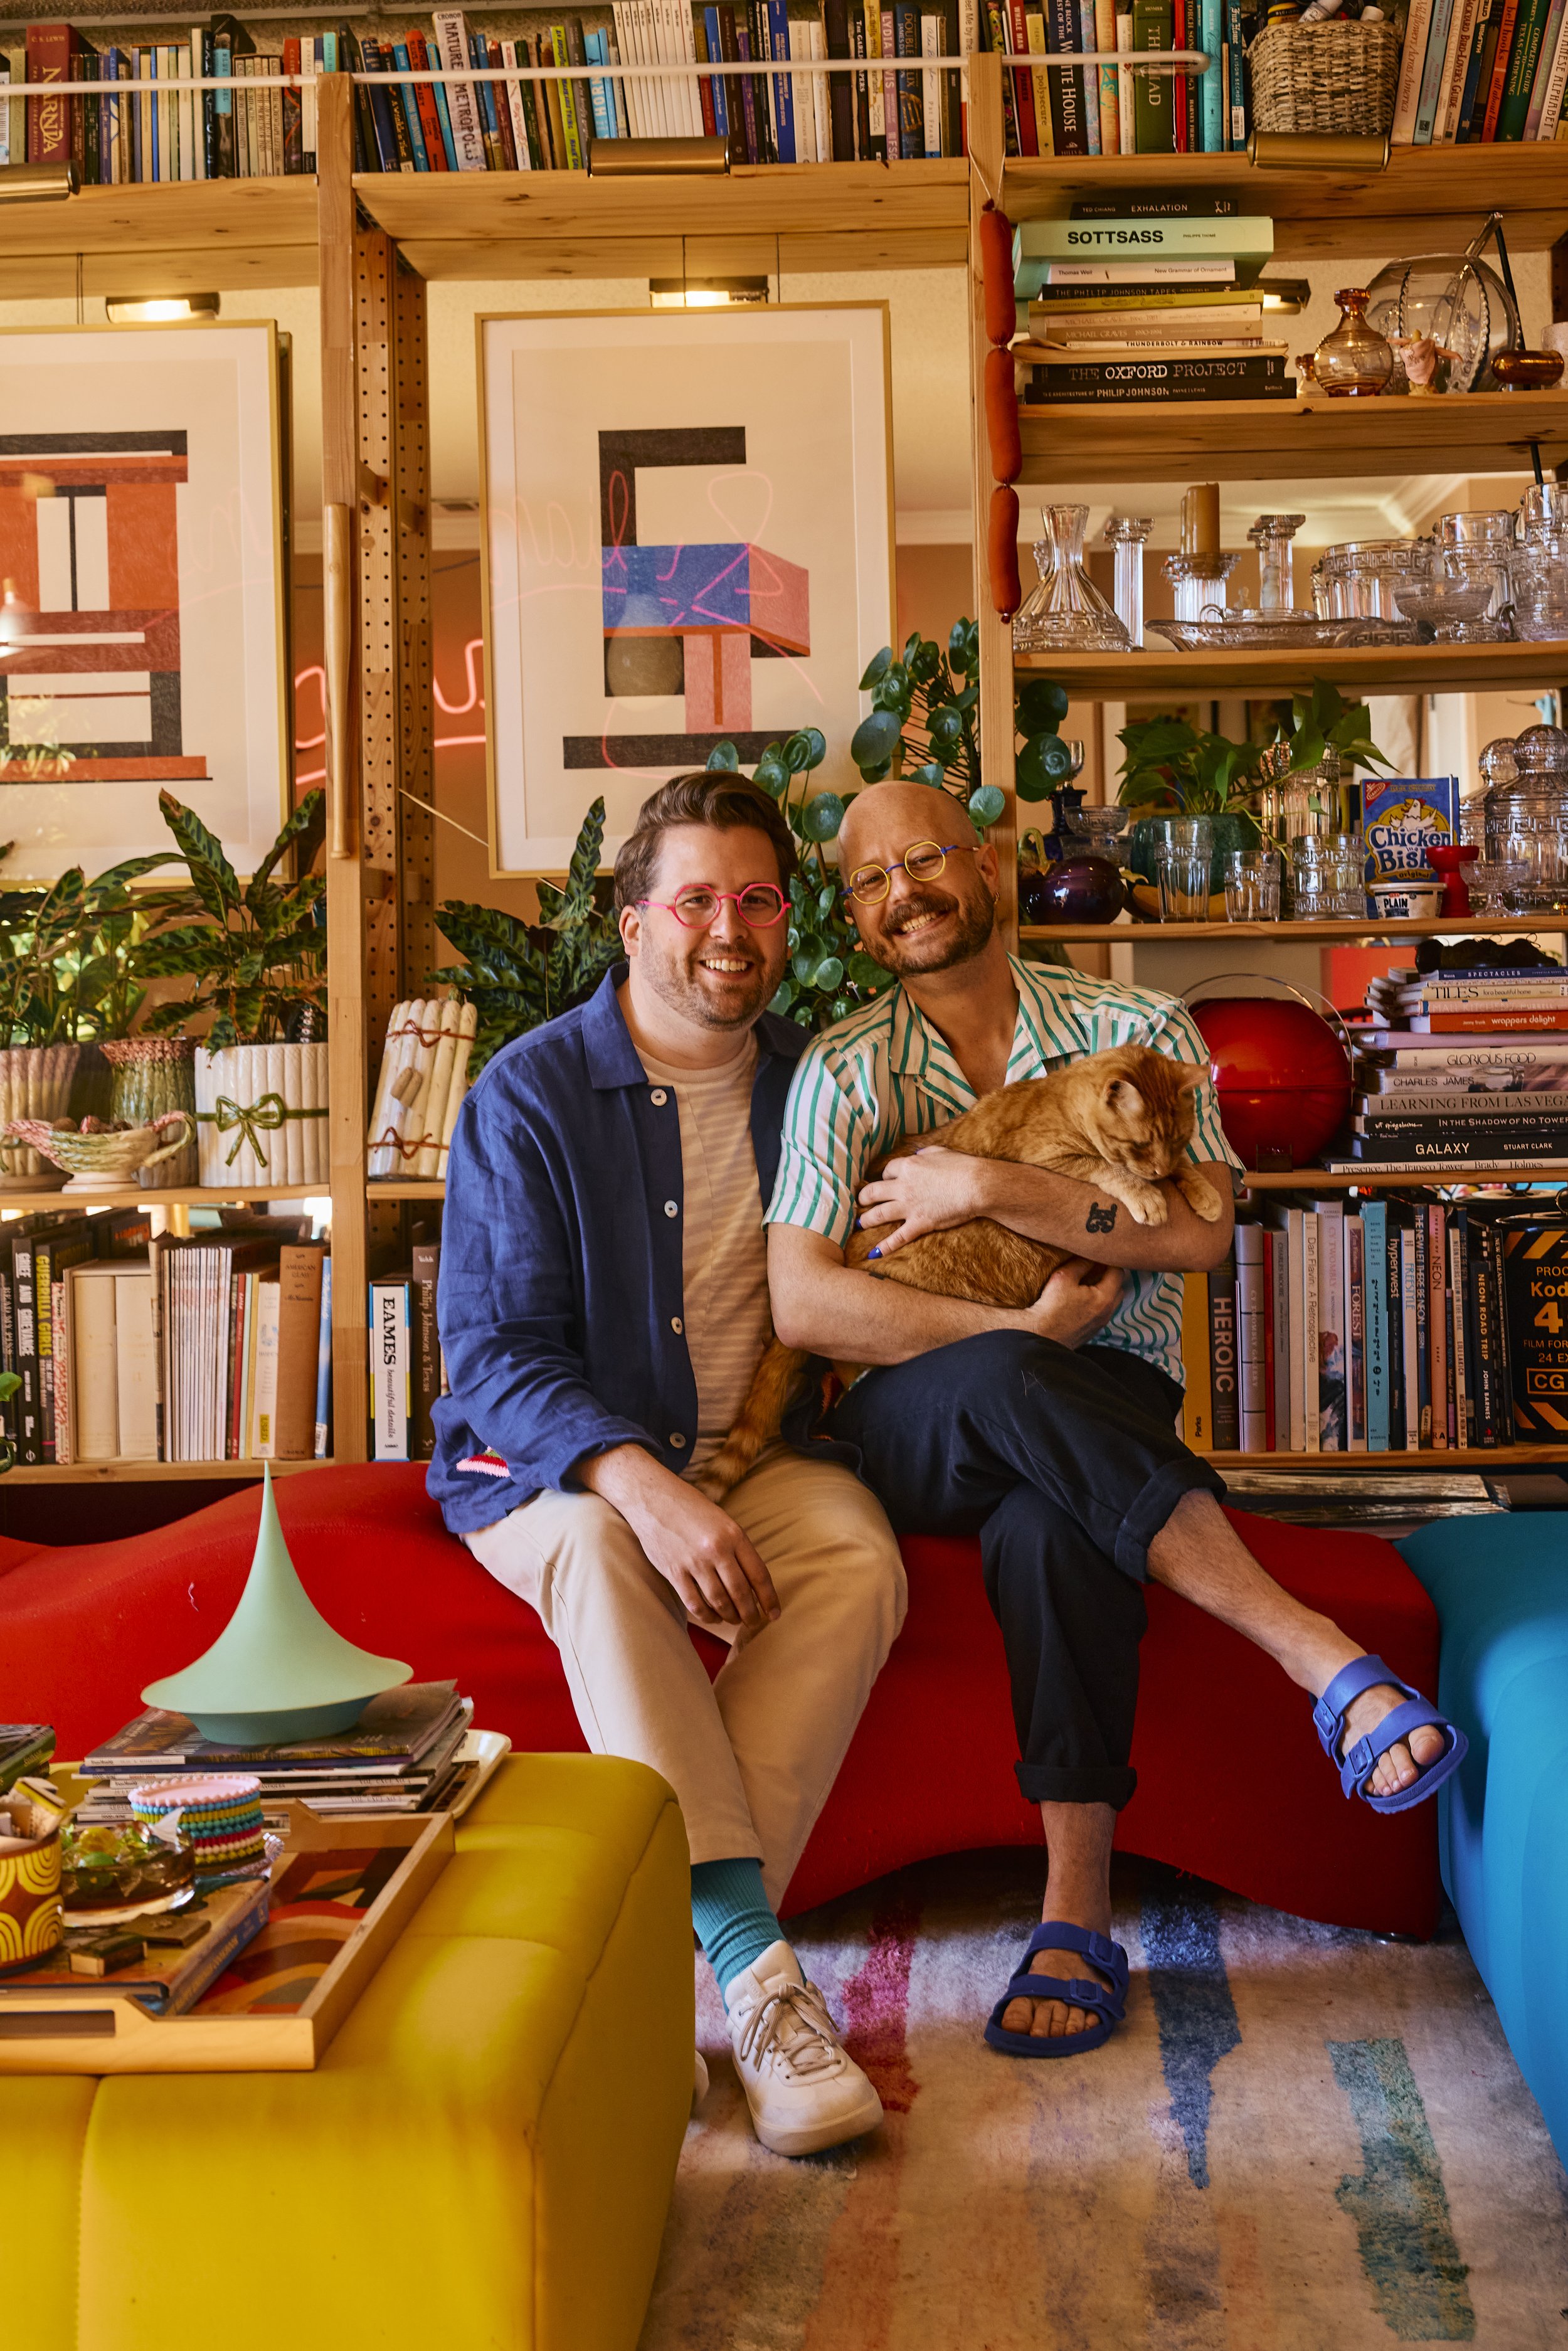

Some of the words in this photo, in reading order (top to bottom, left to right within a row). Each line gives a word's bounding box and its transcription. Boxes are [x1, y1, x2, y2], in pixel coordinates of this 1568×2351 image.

[966, 13, 973, 24] Me
[1229, 7, 1240, 23] Fun
[1505, 6, 1516, 26] bell
[882, 15, 893, 50] LYDIA
[904, 13, 914, 55] DOUBLE
[965, 27, 973, 35] by
[1231, 23, 1241, 45] Home
[1476, 24, 1485, 53] HALPRIN
[1517, 23, 1527, 48] TEXAS
[1498, 29, 1512, 60] hooks
[1527, 27, 1541, 68] COMPLETE
[1406, 45, 1419, 73] Across
[1453, 34, 1470, 82] BIRD-LOVER'S
[1057, 13, 1064, 23] OF
[1062, 88, 1076, 132] HOUSE
[1494, 77, 1502, 88] all
[1508, 50, 1522, 95] GARDENING
[1522, 70, 1532, 93] GUIDE
[1036, 75, 1047, 125] polysecure
[1401, 74, 1414, 113] America
[1449, 85, 1461, 108] GUIDE
[1489, 90, 1499, 114] about
[1544, 75, 1563, 129] ALPHABET
[393, 106, 405, 132] Wrinkle
[454, 83, 477, 161] METROPOLIS
[1131, 204, 1188, 213] EXHALATION
[1067, 230, 1163, 245] SOTTSASS
[1168, 267, 1193, 275] Grammar
[1066, 317, 1097, 326] MICHAEL
[1099, 316, 1126, 324] GRAVES
[1069, 368, 1099, 381] THE
[1104, 365, 1168, 379] OXFORD
[1172, 362, 1247, 378] PROJECT
[1097, 388, 1124, 398] PHILIP
[1125, 387, 1169, 396] JOHNSON
[1370, 827, 1450, 849] Chicken
[1384, 898, 1408, 908] PLAIN
[1431, 987, 1479, 999] TILES
[1491, 1016, 1527, 1027] wrappers
[1529, 1015, 1555, 1026] delight
[1447, 1053, 1503, 1066] GLORIOUS
[1504, 1053, 1536, 1064] FOOD
[1393, 1078, 1438, 1086] CHARLES
[1443, 1077, 1475, 1085] JAMES
[1380, 1098, 1456, 1110] LEARNING
[1461, 1096, 1500, 1108] FROM
[1505, 1096, 1531, 1107] LAS
[1439, 1118, 1448, 1127] IN
[1468, 1118, 1507, 1126] SHADOW
[1522, 1117, 1536, 1125] NO
[1415, 1142, 1470, 1155] GALAXY
[1342, 1165, 1382, 1174] Presence,
[1384, 1164, 1402, 1172] The
[1438, 1162, 1464, 1170] Tower
[1475, 1160, 1499, 1169] Brady
[1510, 1160, 1543, 1168] Holmes
[1330, 1226, 1337, 1240] CY
[1415, 1214, 1424, 1228] THE
[1308, 1237, 1316, 1255] Dan
[1416, 1229, 1424, 1249] NEW
[18, 1253, 32, 1278] GRIEF
[1328, 1243, 1338, 1288] TWOMBLY
[1387, 1238, 1400, 1298] hyperwest
[1416, 1250, 1424, 1263] LET
[1308, 1258, 1316, 1285] Flavin:
[1416, 1264, 1425, 1287] THERE
[1432, 1256, 1442, 1290] NEON
[19, 1285, 33, 1303] AND
[36, 1255, 51, 1319] GUERRILLA
[419, 1279, 433, 1309] Philip
[1405, 1262, 1416, 1310] FREESTYLE
[1417, 1288, 1425, 1297] BE
[1478, 1273, 1486, 1303] NEON
[1351, 1285, 1362, 1339] FOREST
[1417, 1298, 1426, 1325] NEON
[1480, 1306, 1488, 1335] ROAD
[1534, 1301, 1563, 1334] 4
[19, 1308, 34, 1356] GRIEVANCE
[38, 1322, 52, 1356] GIRLS
[383, 1297, 396, 1366] EAMES
[421, 1311, 433, 1352] Johnson
[1306, 1301, 1317, 1362] Retrospective
[1523, 1339, 1544, 1348] FILM
[1548, 1339, 1568, 1348] FOR
[1214, 1297, 1234, 1393] HEROIC
[1481, 1338, 1489, 1361] TRIP
[1538, 1352, 1552, 1362] 24
[385, 1368, 395, 1408] beautiful
[422, 1364, 433, 1393] Texas
[1534, 1373, 1565, 1390] CG
[387, 1409, 396, 1438] details
